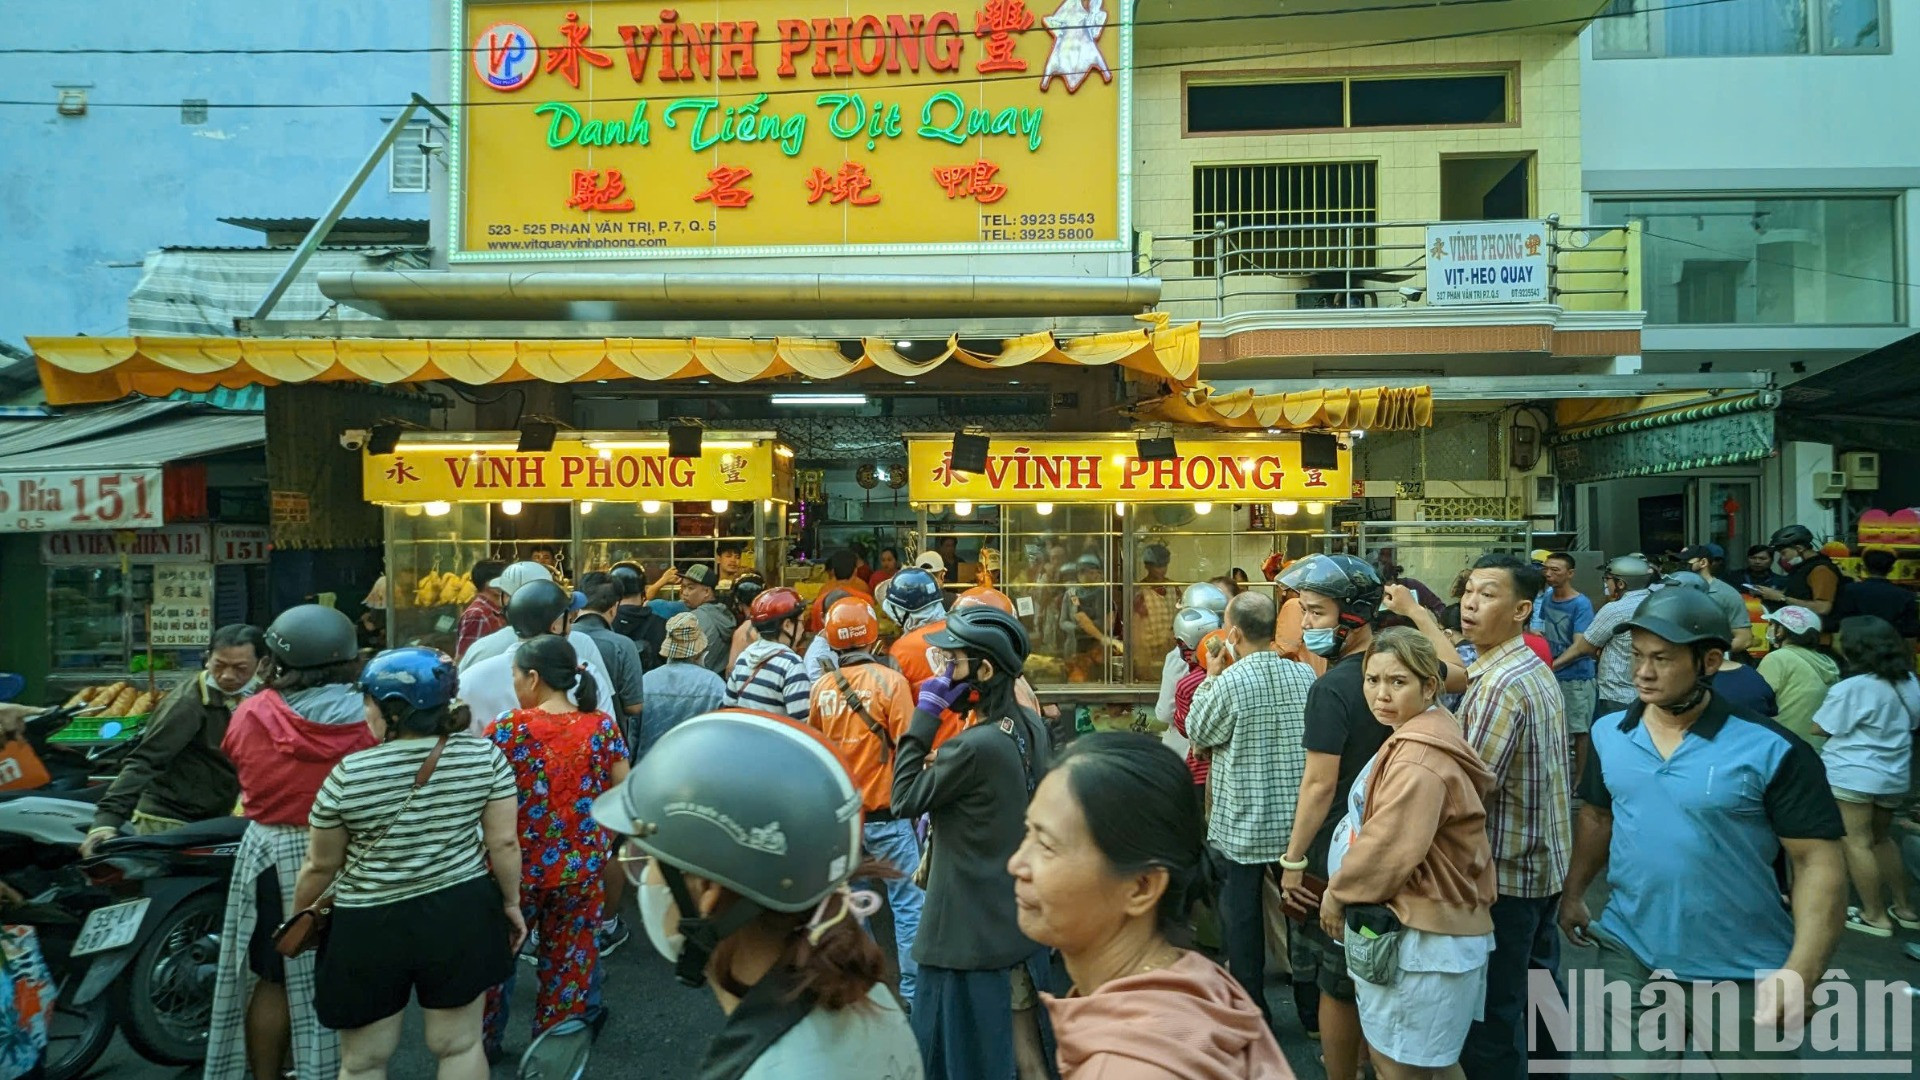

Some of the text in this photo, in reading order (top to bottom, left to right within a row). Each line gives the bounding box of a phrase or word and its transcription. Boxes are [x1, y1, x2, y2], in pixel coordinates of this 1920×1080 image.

[546, 11, 613, 88] 永
[777, 12, 964, 77] PHONG
[534, 90, 1043, 155] Danh Tiếng Vịt Quay
[488, 225, 511, 235] 523
[523, 224, 547, 235] 525
[550, 223, 590, 234] PHAN
[595, 219, 622, 233] VĂN
[982, 214, 1016, 226] TEL:
[982, 229, 1016, 241] TEL:
[1481, 233, 1523, 260] PHONG
[1500, 265, 1533, 284] QUAY
[386, 457, 421, 484] 永
[561, 455, 696, 488] PHONG
[986, 447, 1102, 489] VĨNH
[1120, 456, 1285, 490] PHONG
[18, 477, 62, 512] Bía
[71, 473, 154, 521] 151
[177, 533, 201, 554] 151
[226, 542, 263, 559] 151
[850, 629, 867, 638] Food
